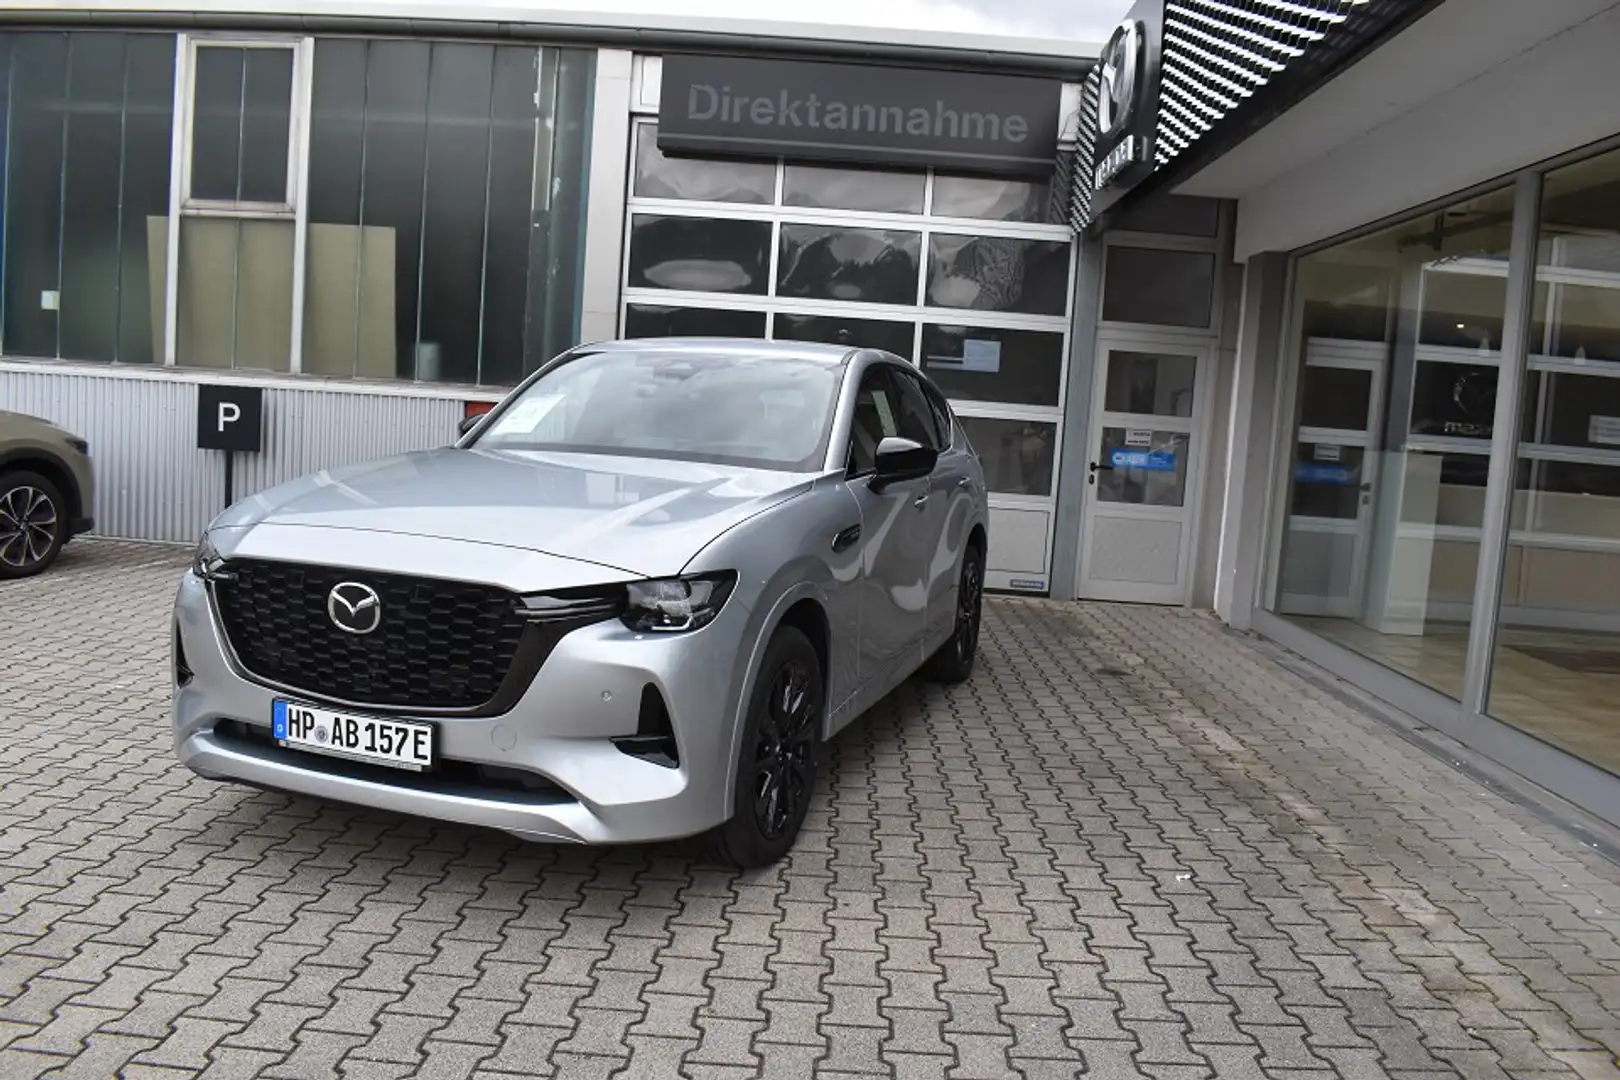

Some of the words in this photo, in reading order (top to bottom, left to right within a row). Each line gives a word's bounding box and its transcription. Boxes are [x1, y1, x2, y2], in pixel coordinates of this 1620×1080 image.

[688, 84, 1029, 143] Direktannahme
[218, 402, 240, 431] P
[288, 708, 315, 739] HP
[331, 717, 359, 748] AB
